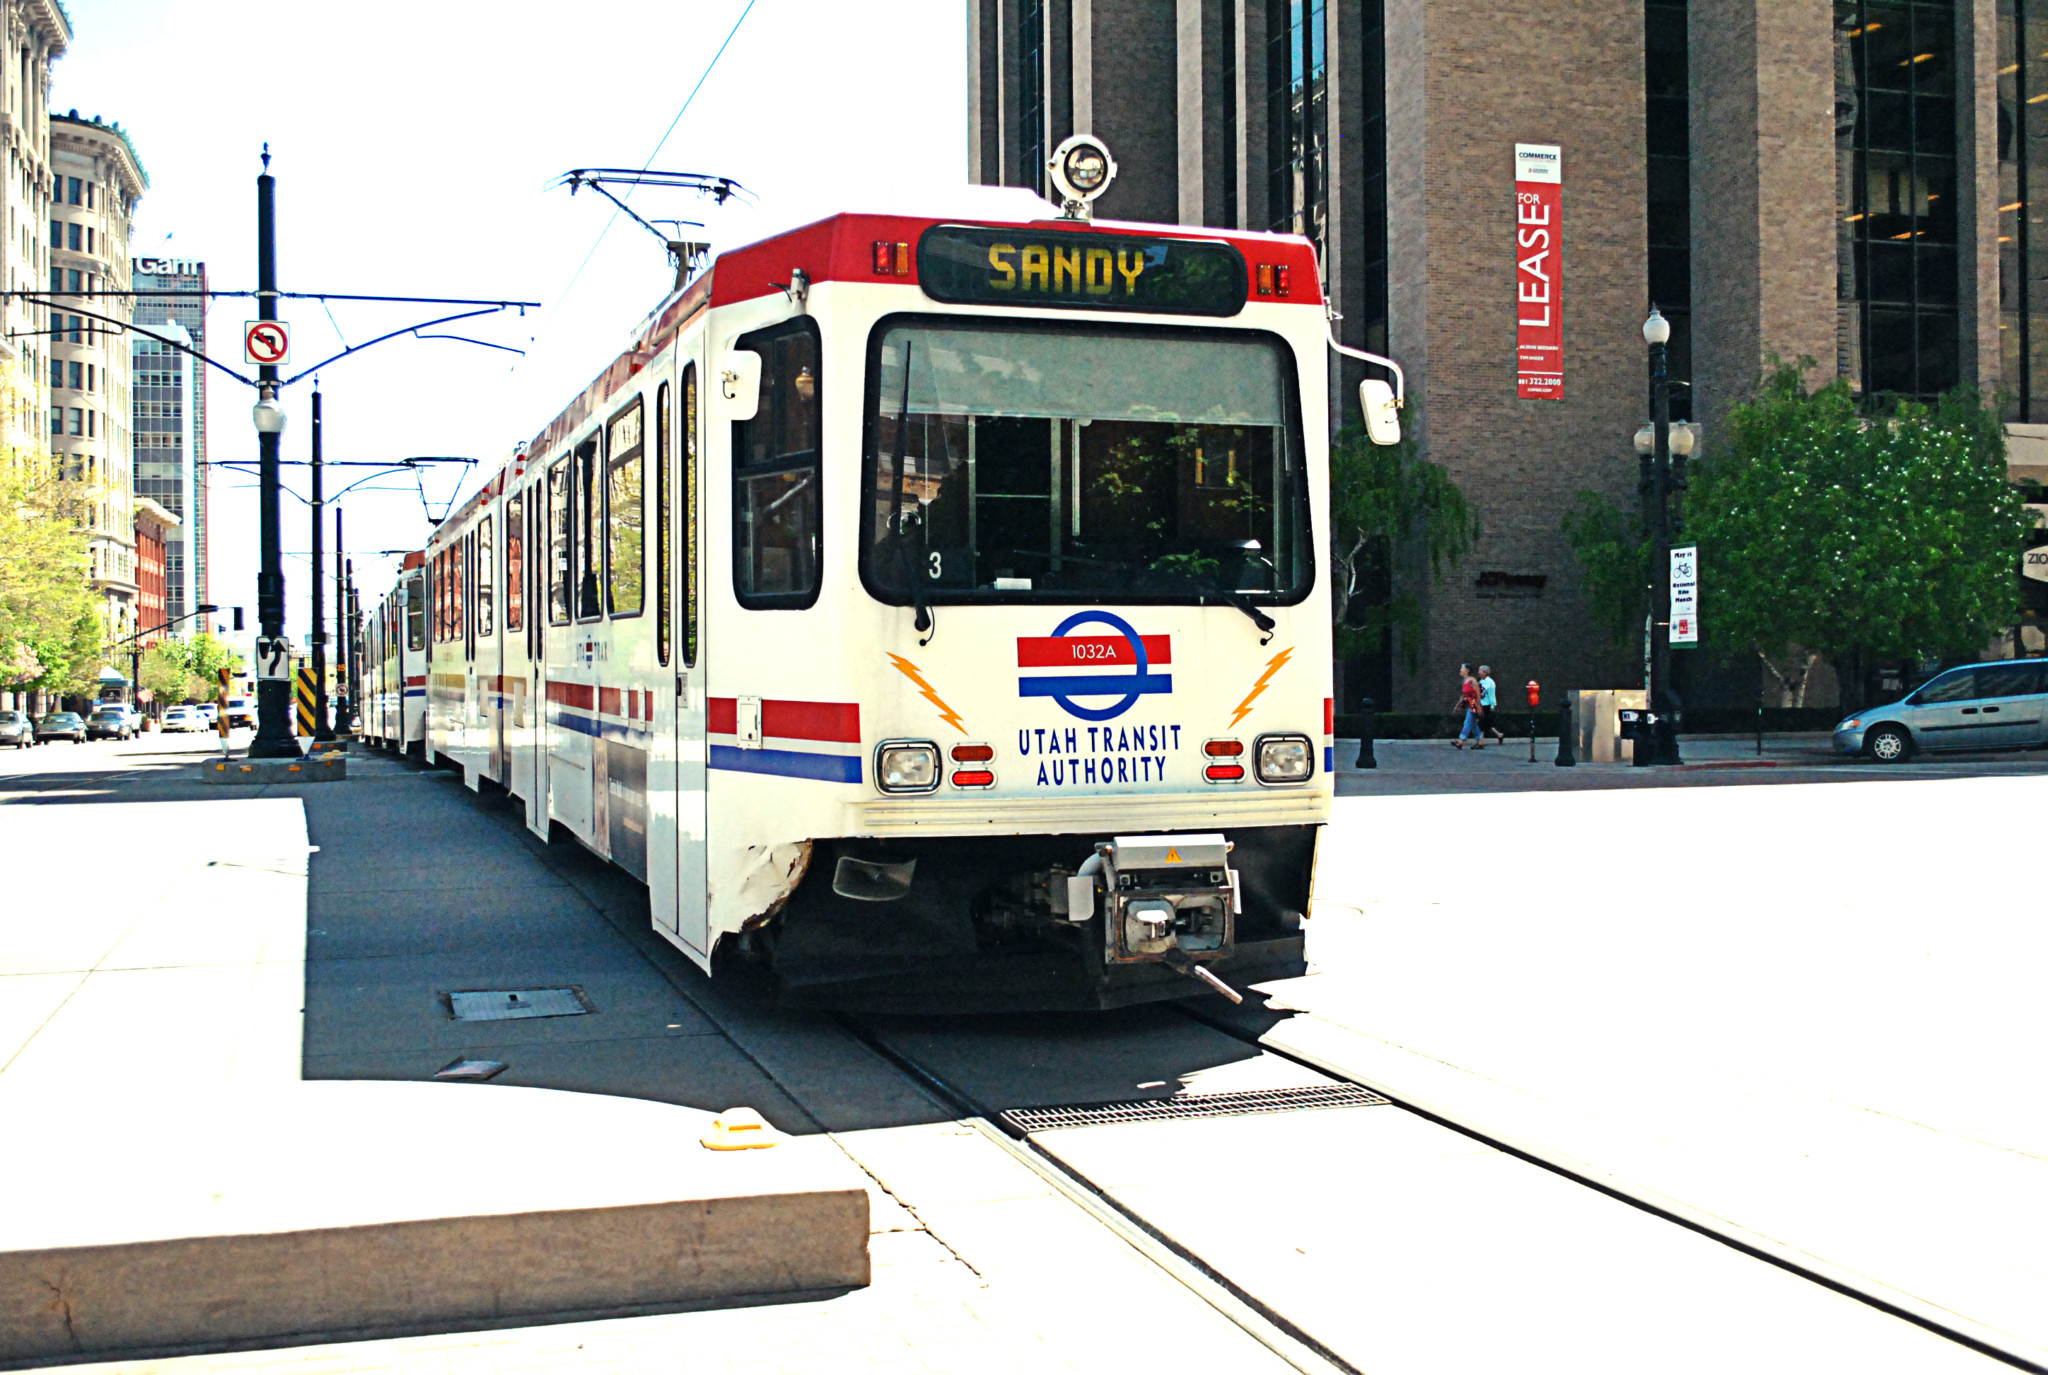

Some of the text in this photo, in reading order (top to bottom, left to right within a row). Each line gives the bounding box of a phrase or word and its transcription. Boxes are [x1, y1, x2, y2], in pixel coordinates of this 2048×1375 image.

[1518, 151, 1557, 160] COMMERCE
[1518, 193, 1540, 204] FOR
[988, 243, 1144, 296] SANDY
[1518, 204, 1550, 327] LEASE
[928, 551, 942, 580] 3
[1071, 644, 1117, 659] 1032A
[1019, 724, 1181, 756] UTAH TRANSIT
[1036, 755, 1166, 786] AUTHORITY
